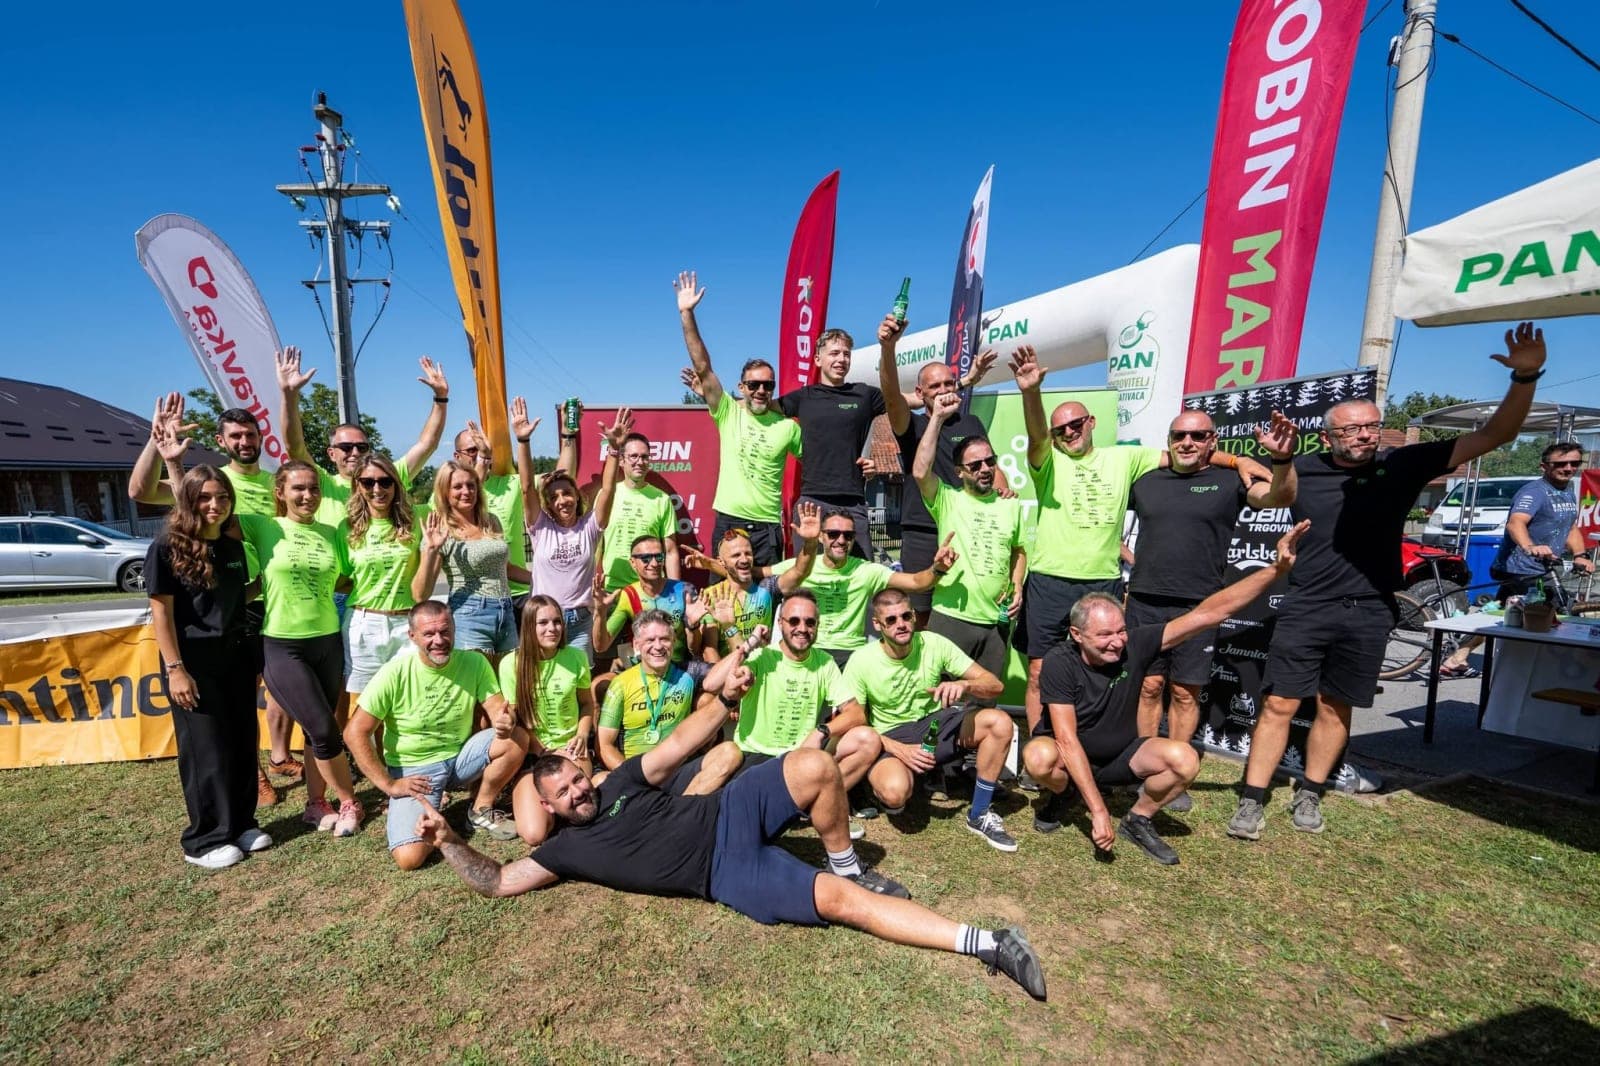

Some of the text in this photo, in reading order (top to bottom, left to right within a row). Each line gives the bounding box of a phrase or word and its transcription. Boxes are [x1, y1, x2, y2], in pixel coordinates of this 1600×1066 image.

[1238, 0, 1322, 211] OBIN
[988, 318, 1029, 344] PAN
[1109, 351, 1155, 373] PAN
[1235, 506, 1294, 527] OBIN
[1248, 523, 1295, 533] TRGOVIN
